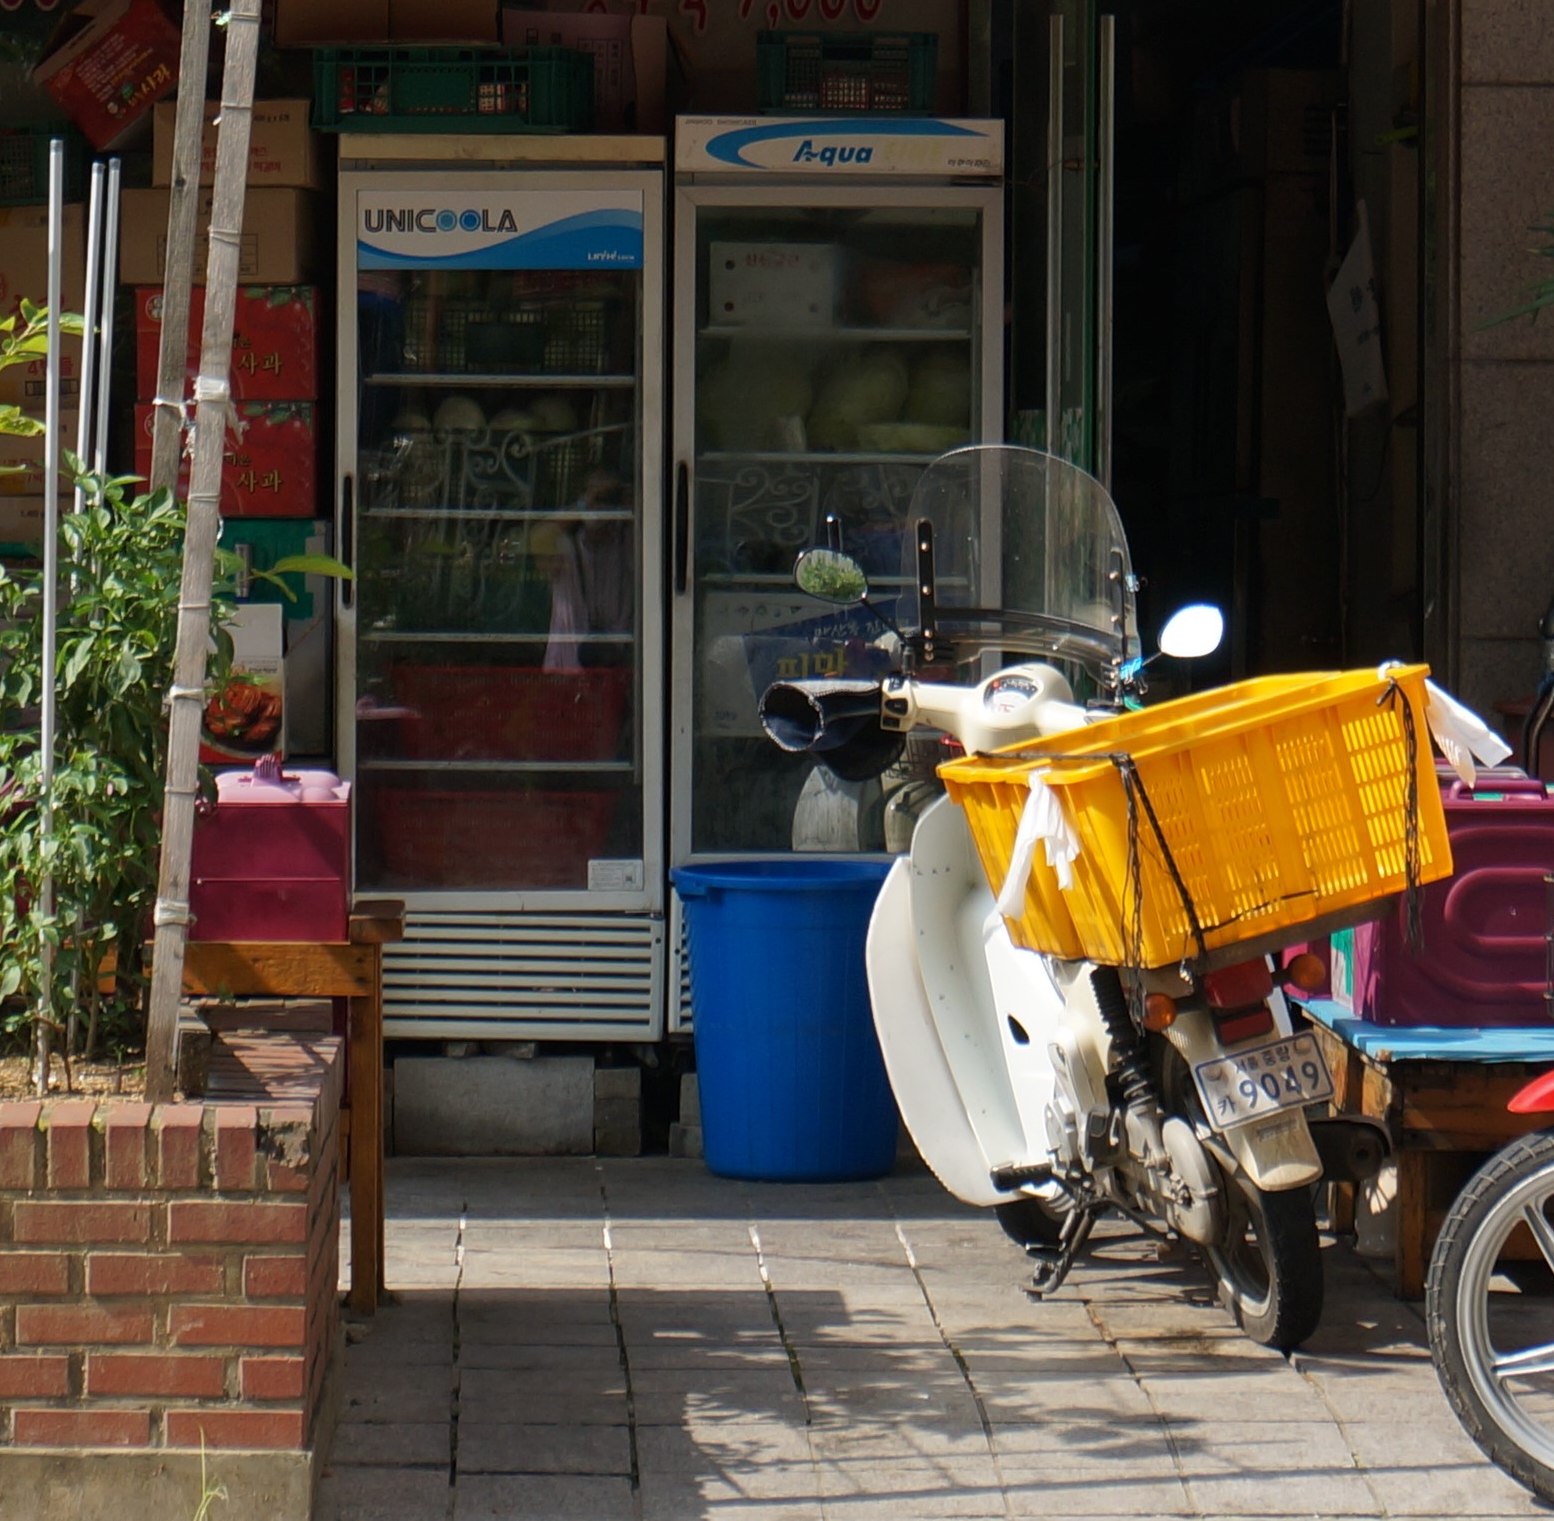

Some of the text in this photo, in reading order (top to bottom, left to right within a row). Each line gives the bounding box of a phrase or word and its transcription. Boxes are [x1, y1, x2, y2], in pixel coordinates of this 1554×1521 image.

[793, 140, 873, 167] Aqua
[365, 209, 518, 233] UNICOOLA
[237, 351, 283, 377] 사과
[237, 469, 283, 494] 사과
[1239, 1061, 1319, 1109] 9049
